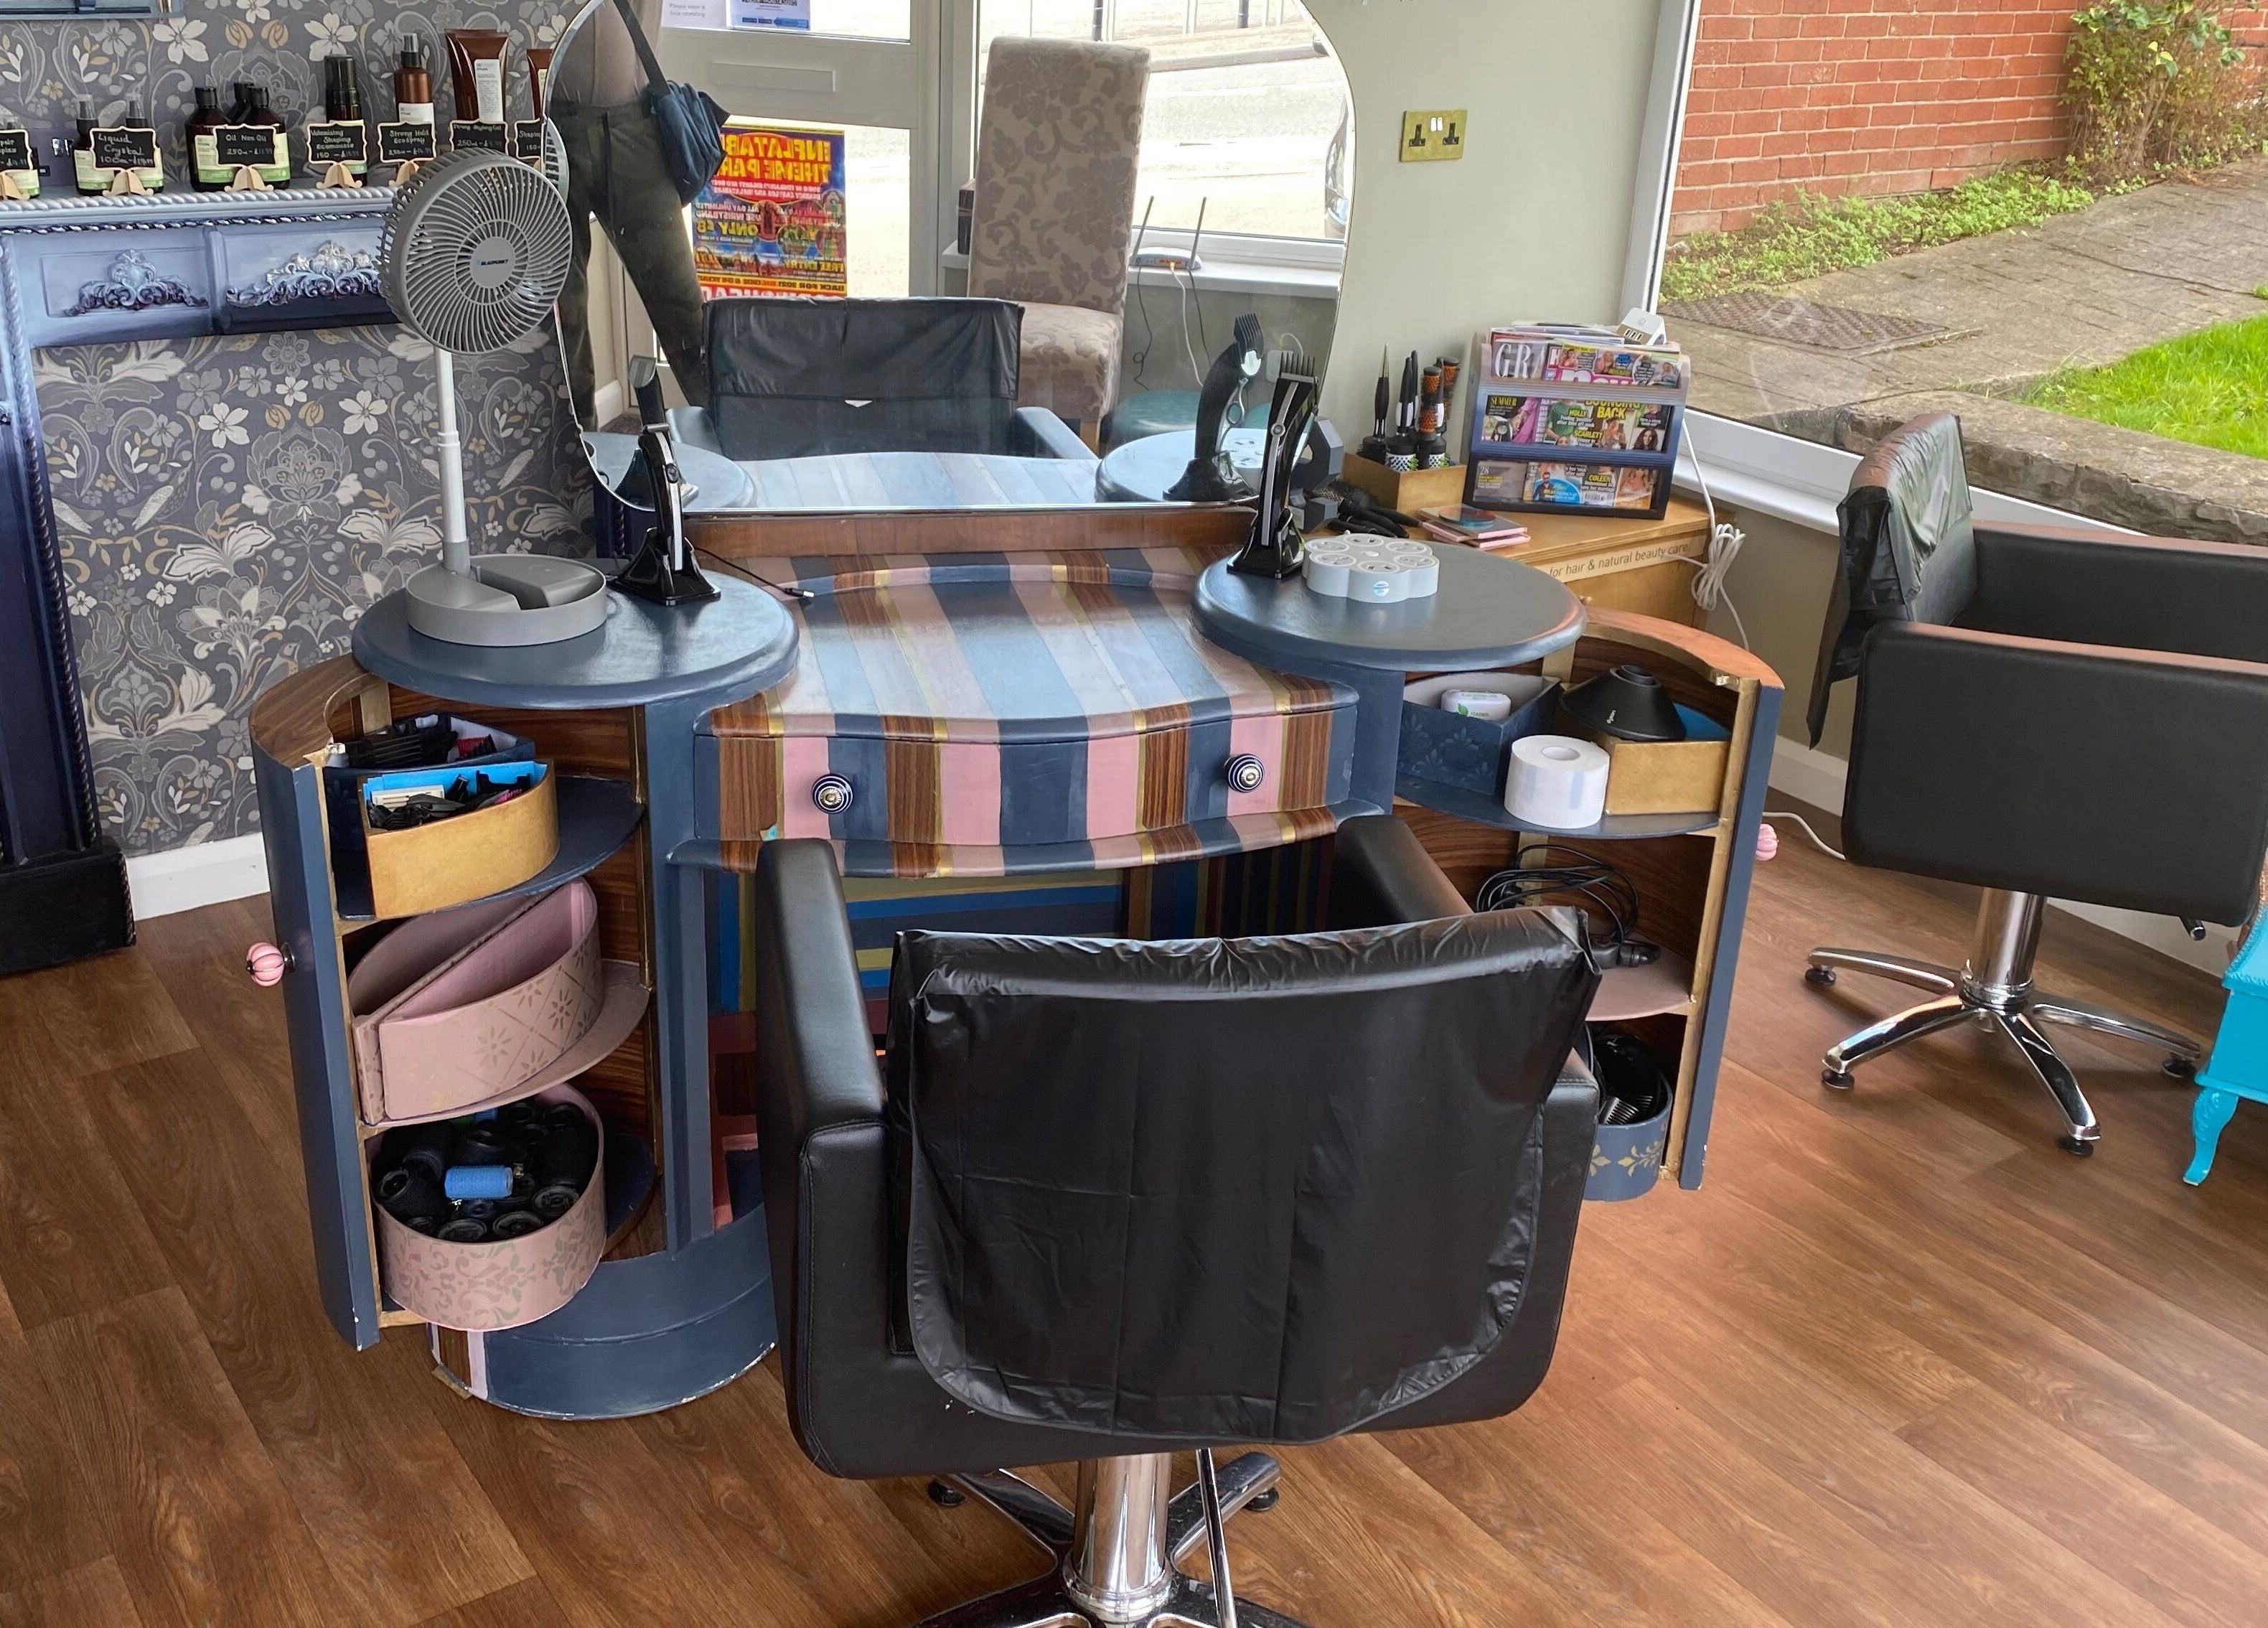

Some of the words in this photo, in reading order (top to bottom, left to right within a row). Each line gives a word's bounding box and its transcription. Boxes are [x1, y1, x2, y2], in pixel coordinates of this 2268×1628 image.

[98, 133, 133, 145] Liquid
[104, 144, 144, 158] Crystal
[1495, 343, 1546, 379] GRA
[1491, 396, 1517, 406] SUMMER
[1569, 409, 1588, 418] HOLLY
[1597, 406, 1626, 420] BACK
[1574, 431, 1603, 440] SCARLETT
[1588, 474, 1612, 483] COLEEN
[1549, 566, 1564, 578] for
[1565, 563, 1586, 576] hair
[1588, 558, 1596, 571] &
[1598, 552, 1633, 569] natural
[1634, 546, 1666, 561] beauty
[1667, 543, 1689, 556] care
